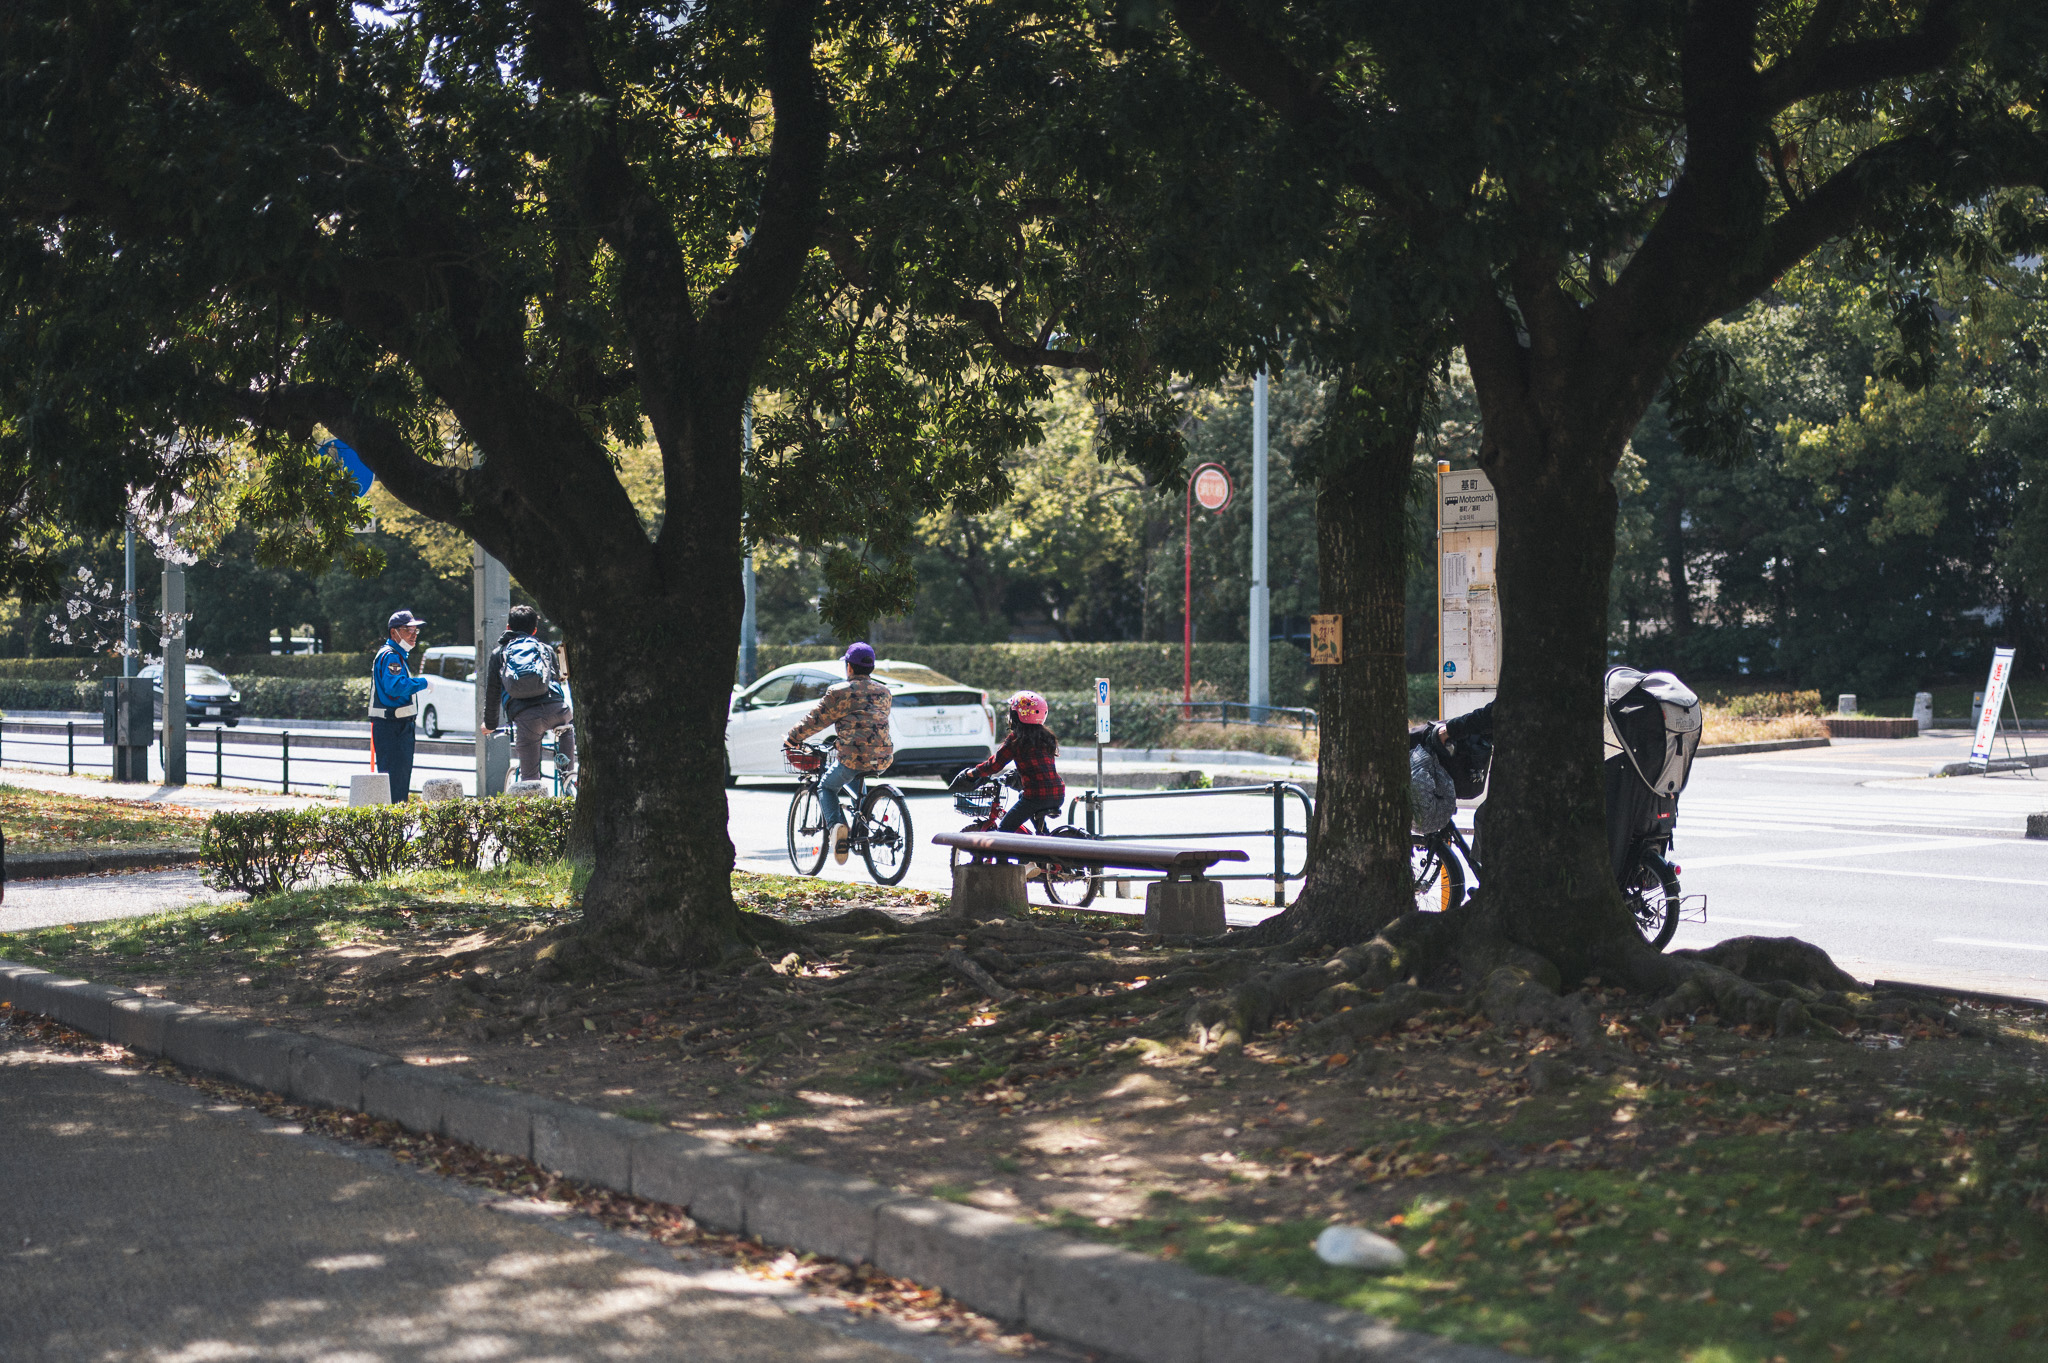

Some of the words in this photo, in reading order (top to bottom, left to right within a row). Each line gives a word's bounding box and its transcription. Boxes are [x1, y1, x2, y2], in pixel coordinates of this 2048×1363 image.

[1461, 479, 1478, 490] 基町
[1459, 493, 1494, 503] Motomachi
[1100, 684, 1107, 697] 54
[1977, 663, 2003, 748] 進入禁止
[1100, 718, 1109, 733] 1.6
